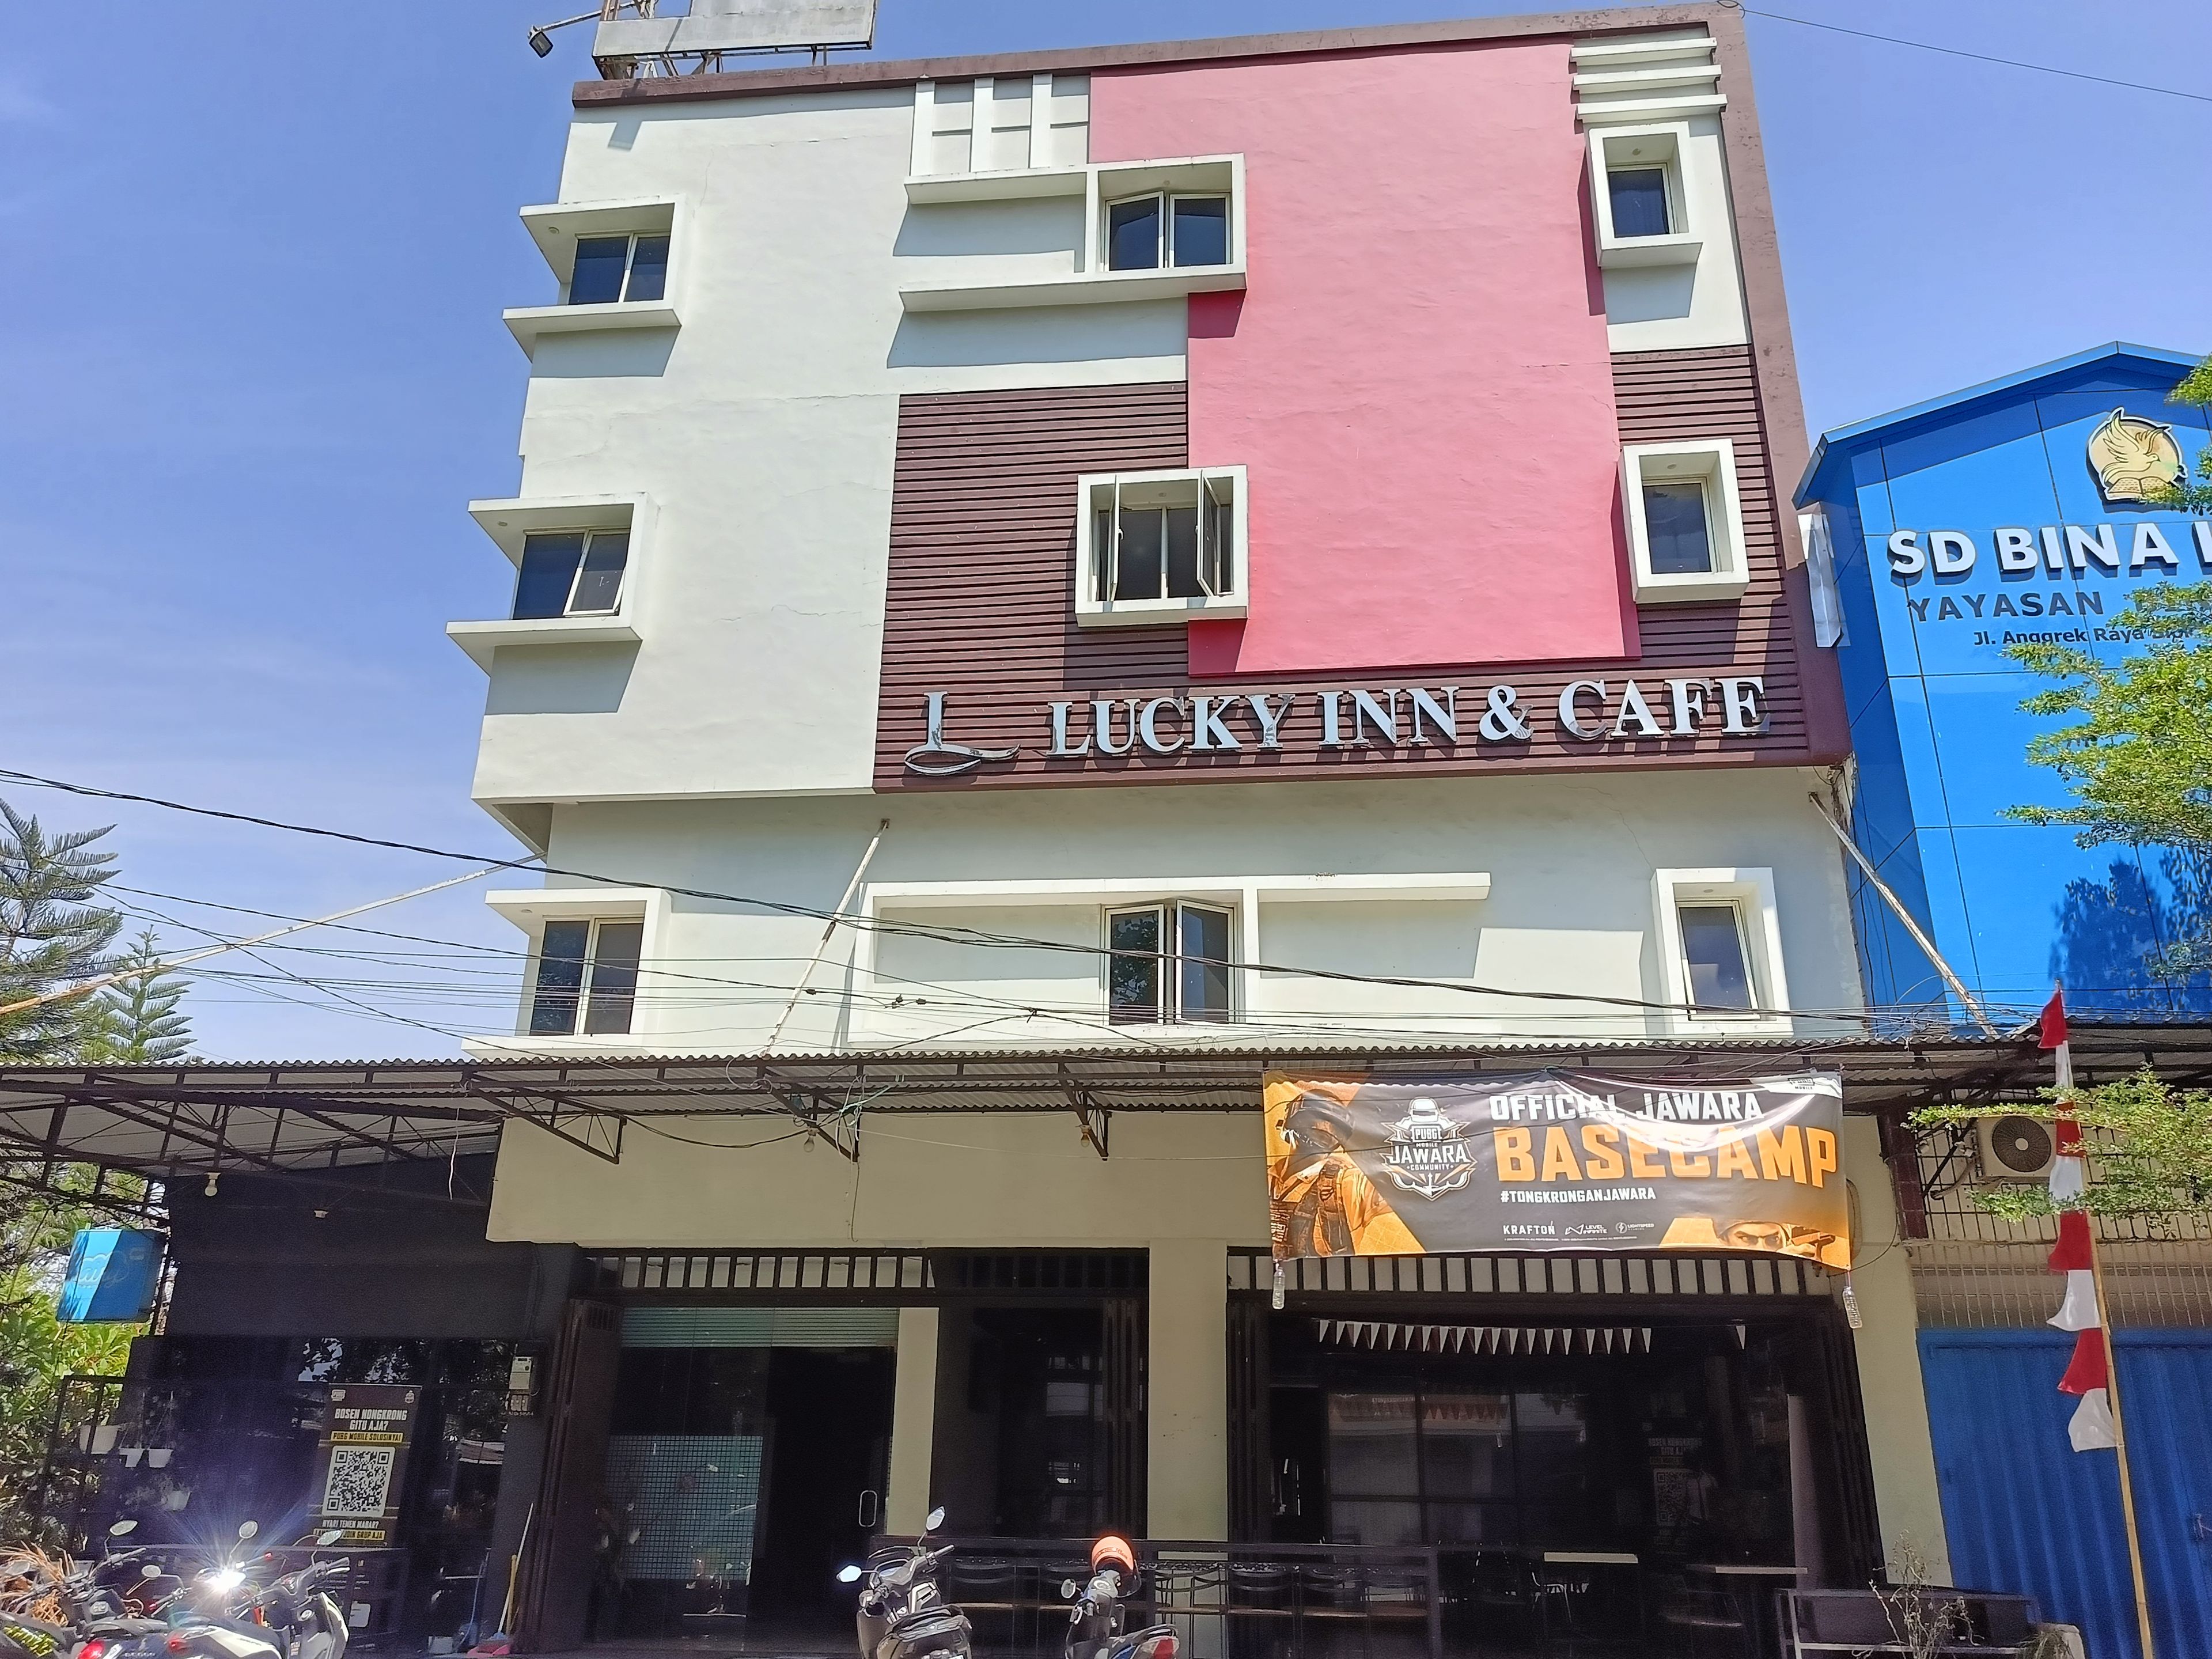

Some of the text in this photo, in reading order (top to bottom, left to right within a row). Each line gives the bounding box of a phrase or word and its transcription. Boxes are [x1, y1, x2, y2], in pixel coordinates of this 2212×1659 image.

[1888, 530, 1976, 574] SD
[1994, 522, 2180, 572] BINA
[1909, 591, 2104, 622] YAYASAN
[1974, 631, 1997, 646] Jl.
[2093, 627, 2145, 644] Raya
[1046, 676, 1771, 757] LUCKY INN & CAFE
[1635, 1092, 1765, 1121] JAWARA
[1415, 1128, 1438, 1140] PUBG
[1387, 1143, 1472, 1164] JAWARA
[1493, 1124, 1838, 1188] BASECAMP
[1500, 1187, 1656, 1203] #TONGKRONGANJAWARA
[1503, 1221, 1555, 1234] KRAFTON
[334, 1408, 361, 1419] BOSEN
[349, 1419, 389, 1431] GITU AJA?
